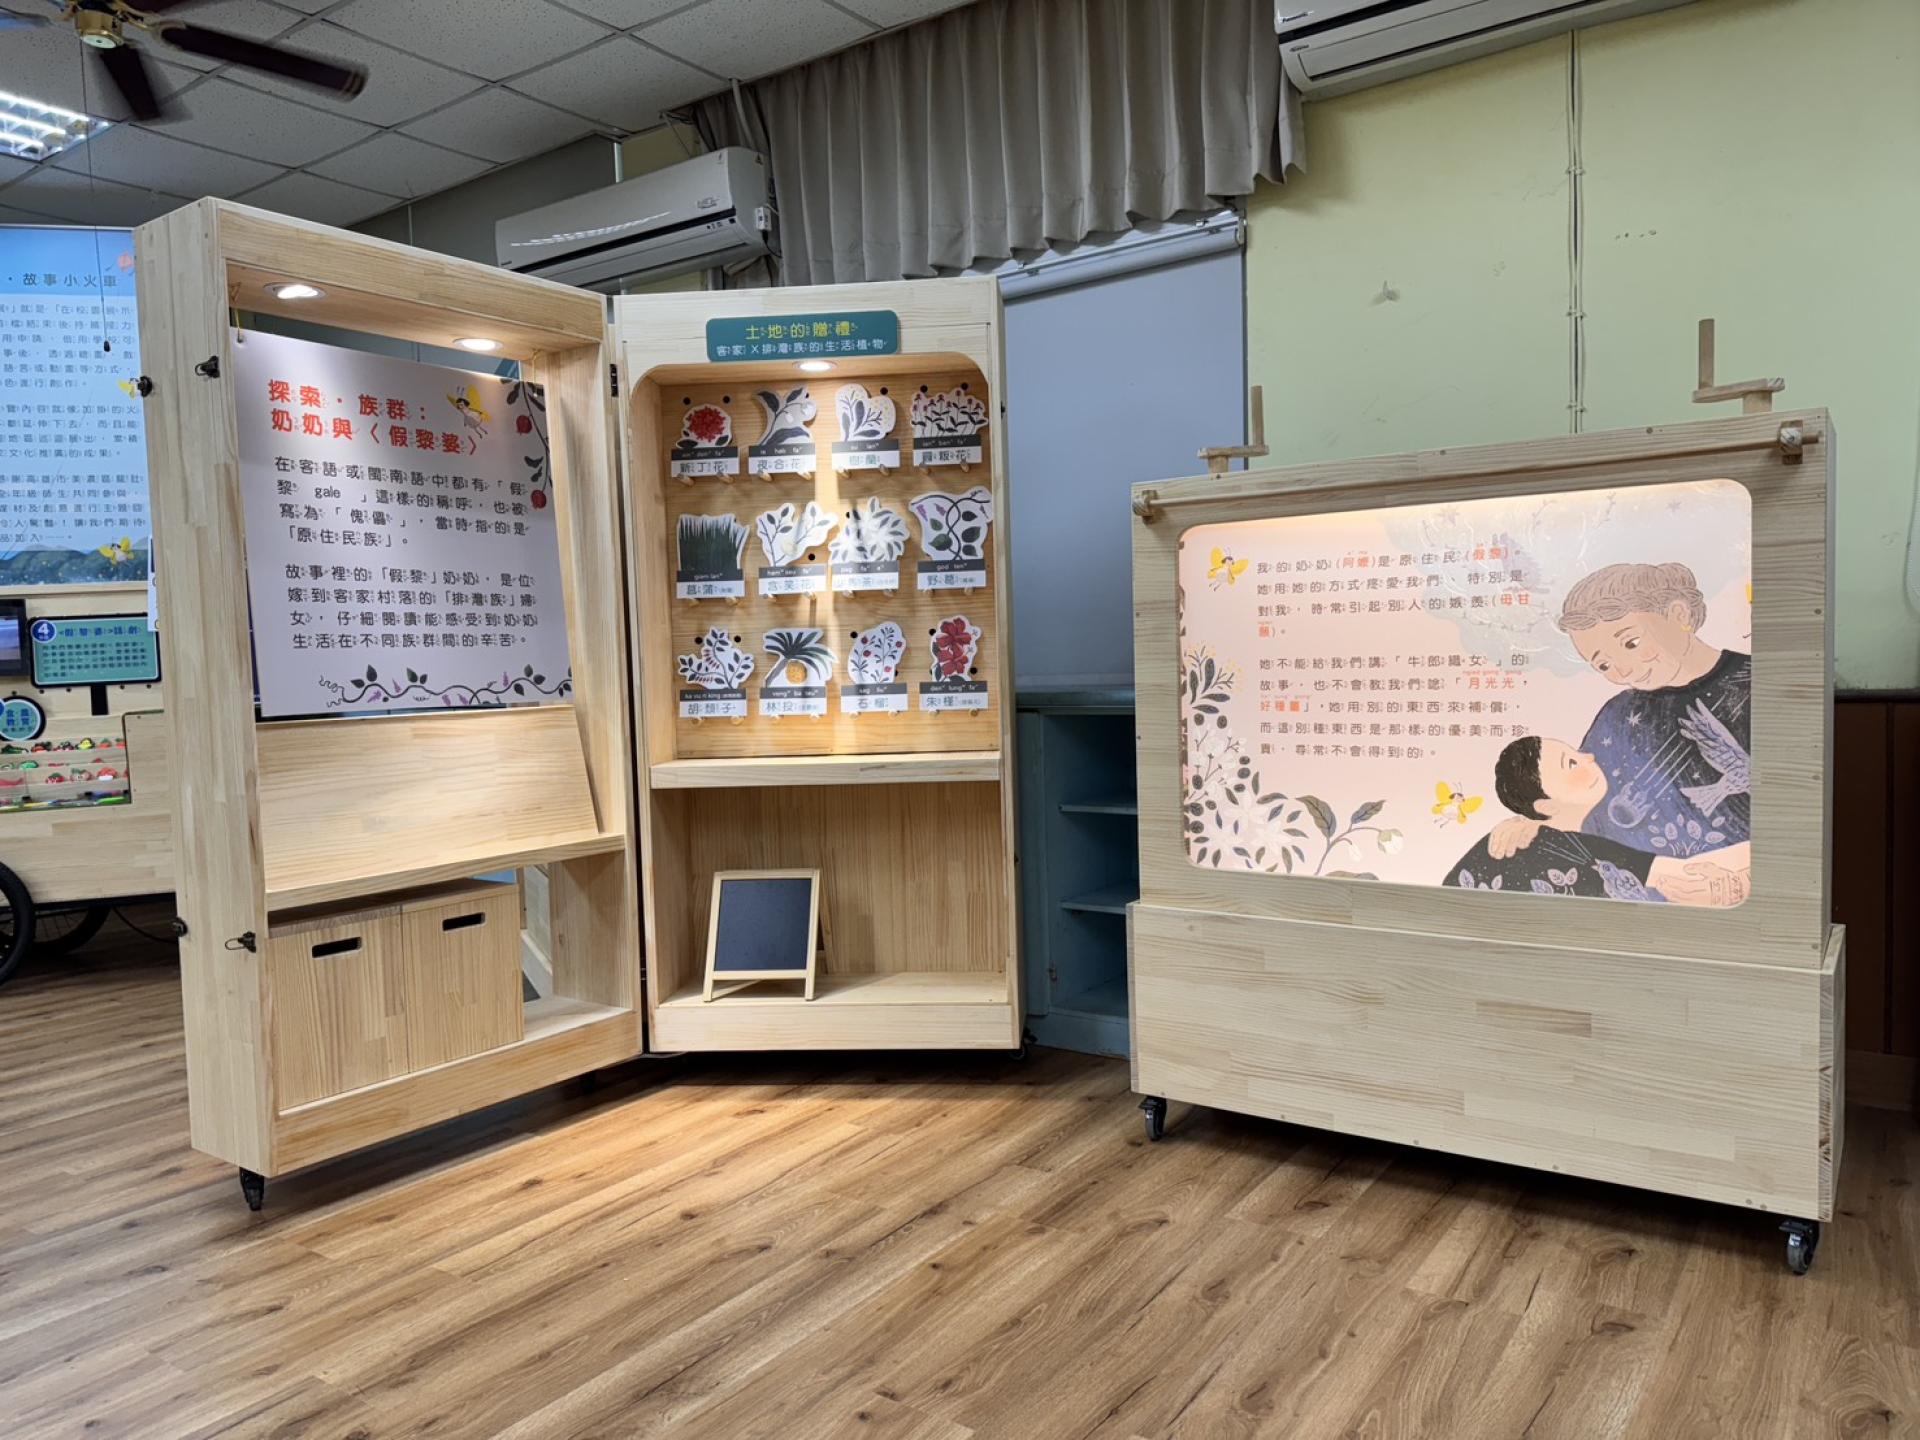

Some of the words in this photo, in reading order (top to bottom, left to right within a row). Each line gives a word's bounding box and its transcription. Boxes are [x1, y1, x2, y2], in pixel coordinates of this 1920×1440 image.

[745, 321, 858, 341] 土地的贈禮
[314, 486, 341, 500] gale
[288, 525, 409, 548] 「原住民族」。
[287, 587, 537, 608] 嫁到客家村落的「排灣族」婦
[290, 611, 539, 628] 女，仔細閱讀能感受到奶奶
[38, 622, 49, 635] 4
[293, 633, 527, 650] 生活在不同族群間的辛苦。
[1259, 653, 1530, 671] 她不能給我們講「牛郎織女」的
[1260, 722, 1530, 738] 而這別種東西是那樣的優美而珍
